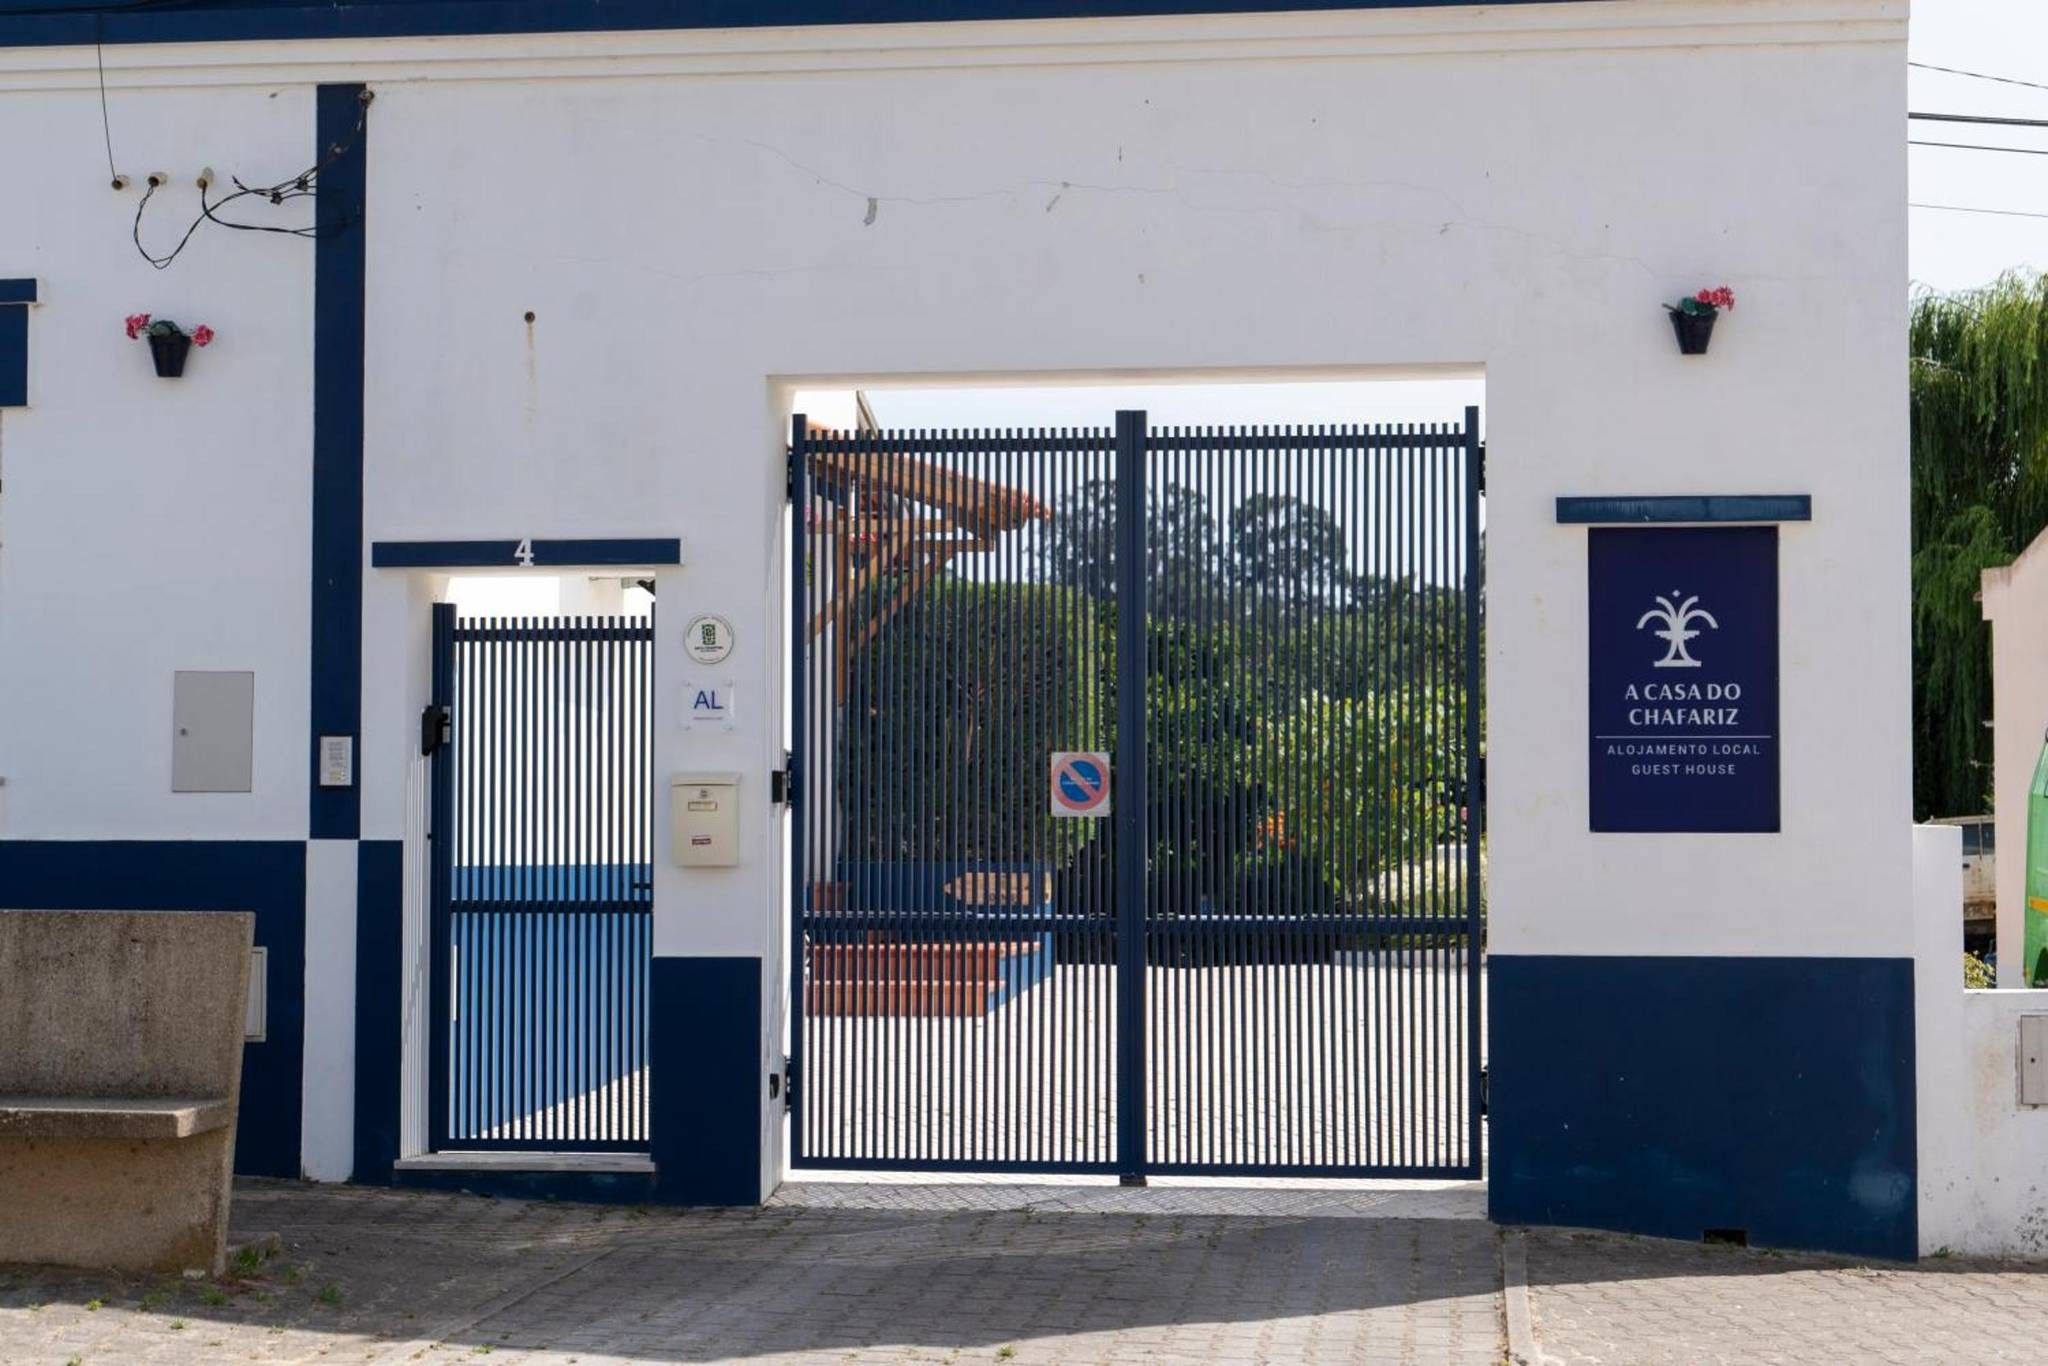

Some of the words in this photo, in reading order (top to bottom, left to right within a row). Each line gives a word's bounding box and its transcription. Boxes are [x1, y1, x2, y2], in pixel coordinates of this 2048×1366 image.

[513, 537, 535, 567] 4
[694, 690, 724, 710] AL
[1625, 683, 1640, 700] A
[1644, 683, 1702, 700] CASA
[1707, 683, 1742, 700] DO
[1628, 708, 1740, 726] CHAFARIZ
[1607, 744, 1708, 756] ALOJAMENTO
[1712, 744, 1761, 756] LOCAL
[1631, 764, 1681, 775] GUEST
[1685, 764, 1736, 775] HOUSE
